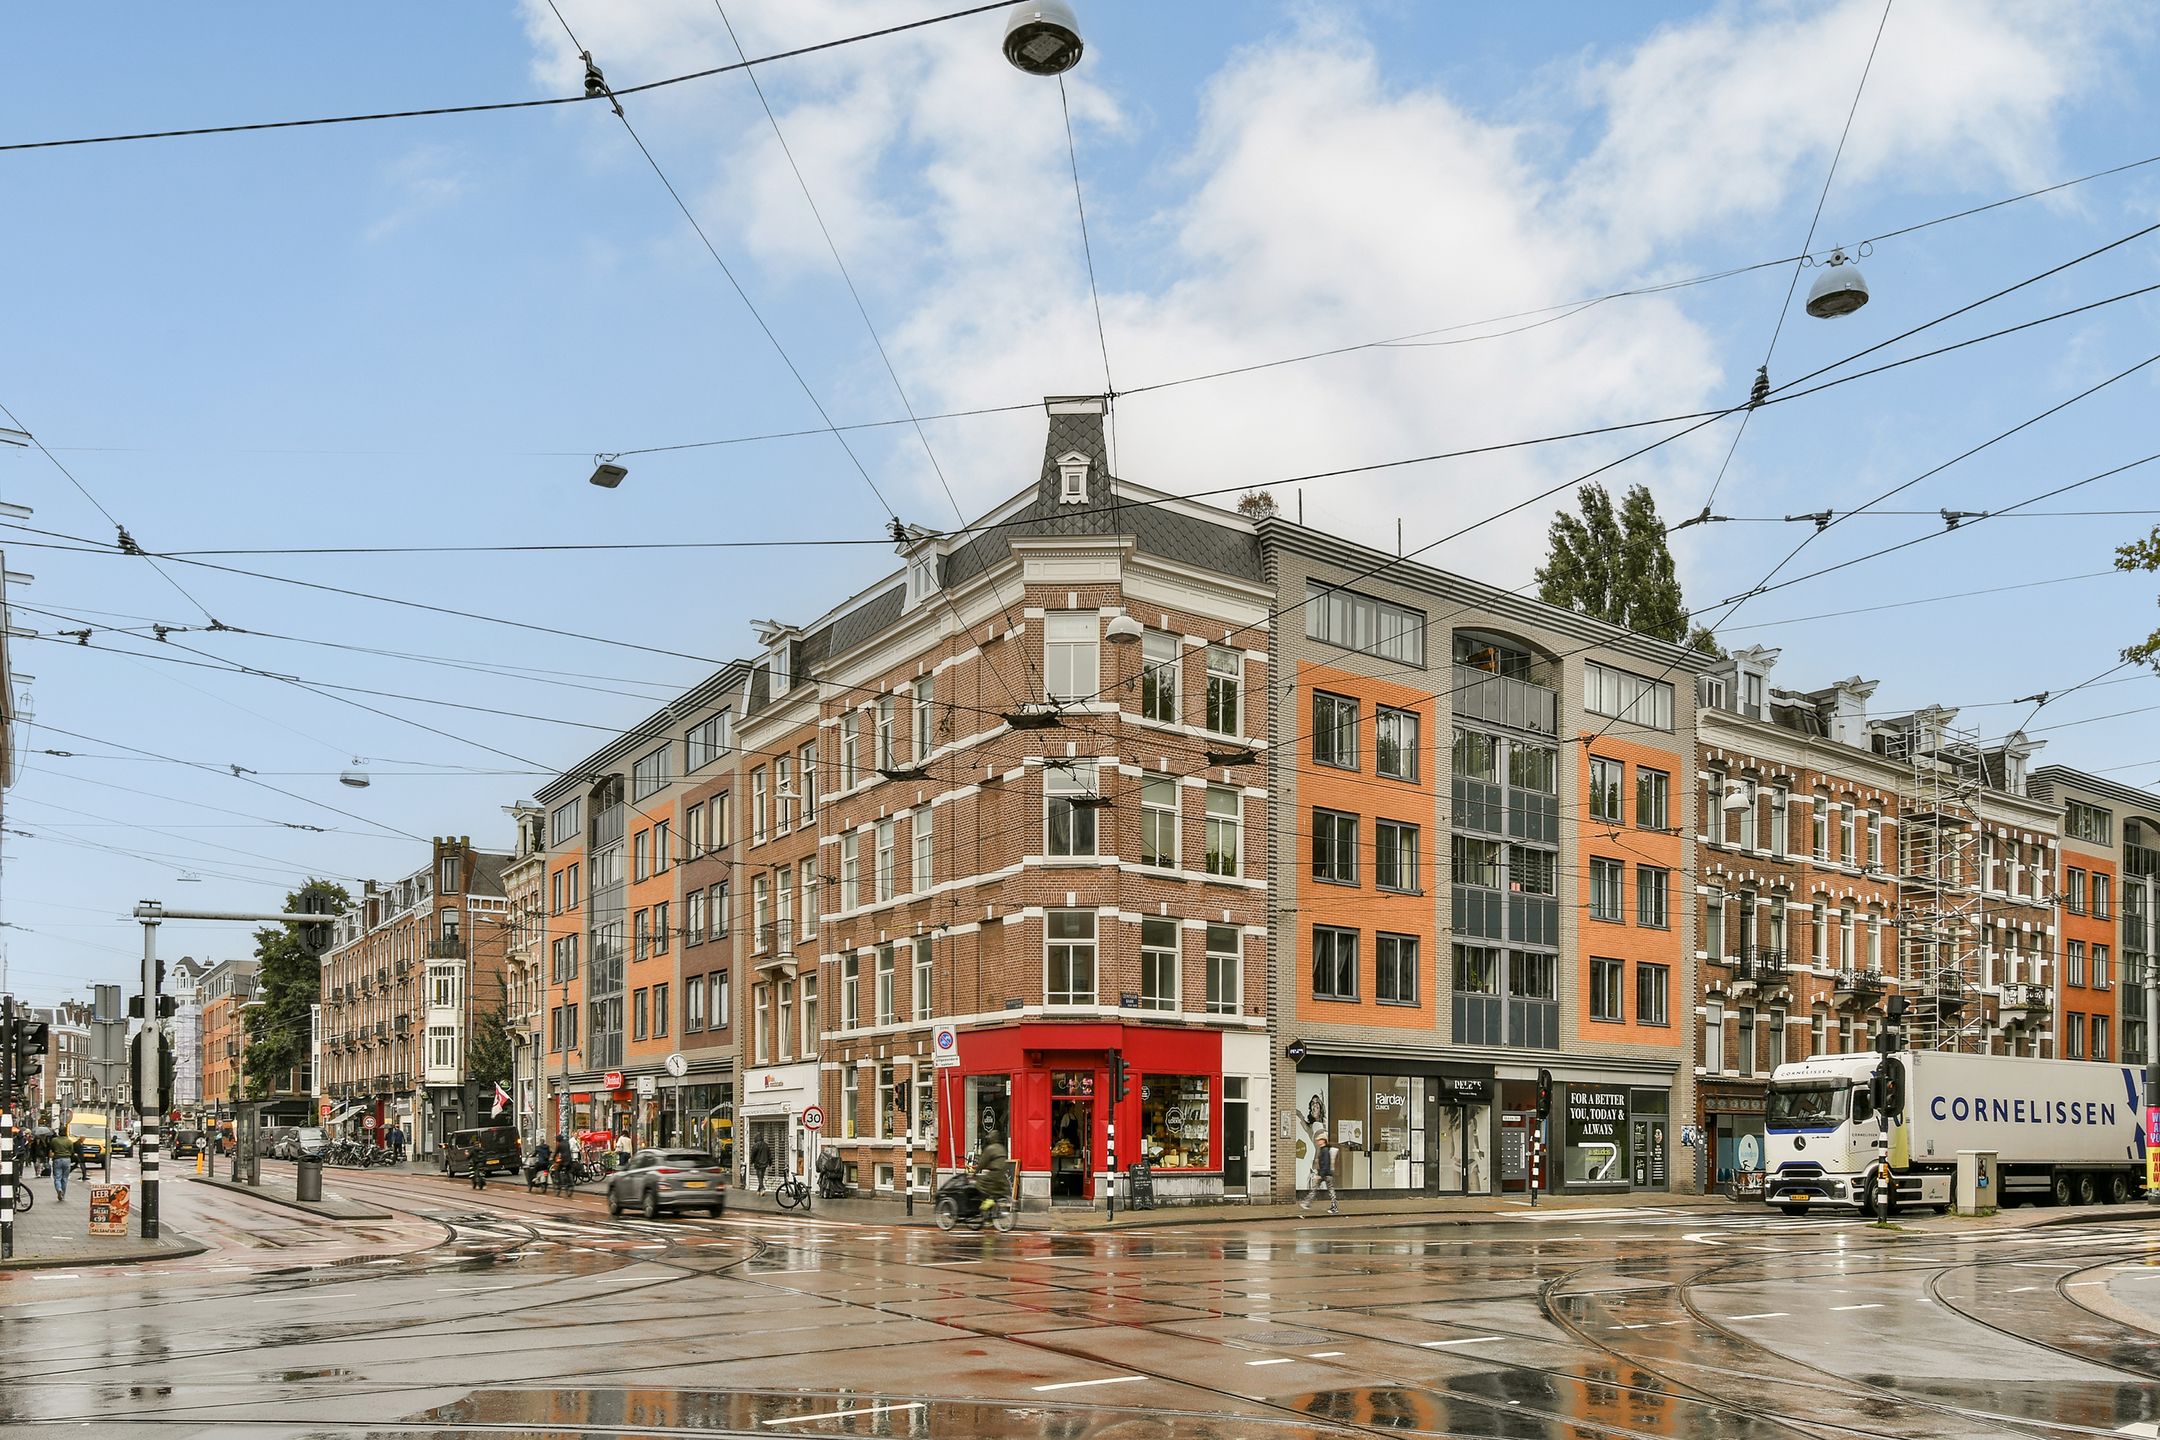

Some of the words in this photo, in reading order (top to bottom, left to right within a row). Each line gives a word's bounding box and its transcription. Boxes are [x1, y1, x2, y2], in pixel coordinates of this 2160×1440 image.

[1780, 1069, 1833, 1077] CORNELISSEN
[1375, 1092, 1406, 1106] Fairday
[1571, 1092, 1588, 1105] FOR
[1588, 1094, 1594, 1105] A
[1595, 1094, 1625, 1106] BETTER
[1570, 1107, 1590, 1121] YOU,
[1590, 1108, 1617, 1120] TODAY
[1618, 1109, 1625, 1120] &
[1930, 1096, 2116, 1126] CORNELISSEN
[806, 1113, 821, 1124] 30
[1582, 1123, 1613, 1135] ALWAYS
[93, 1190, 109, 1198] LEER
